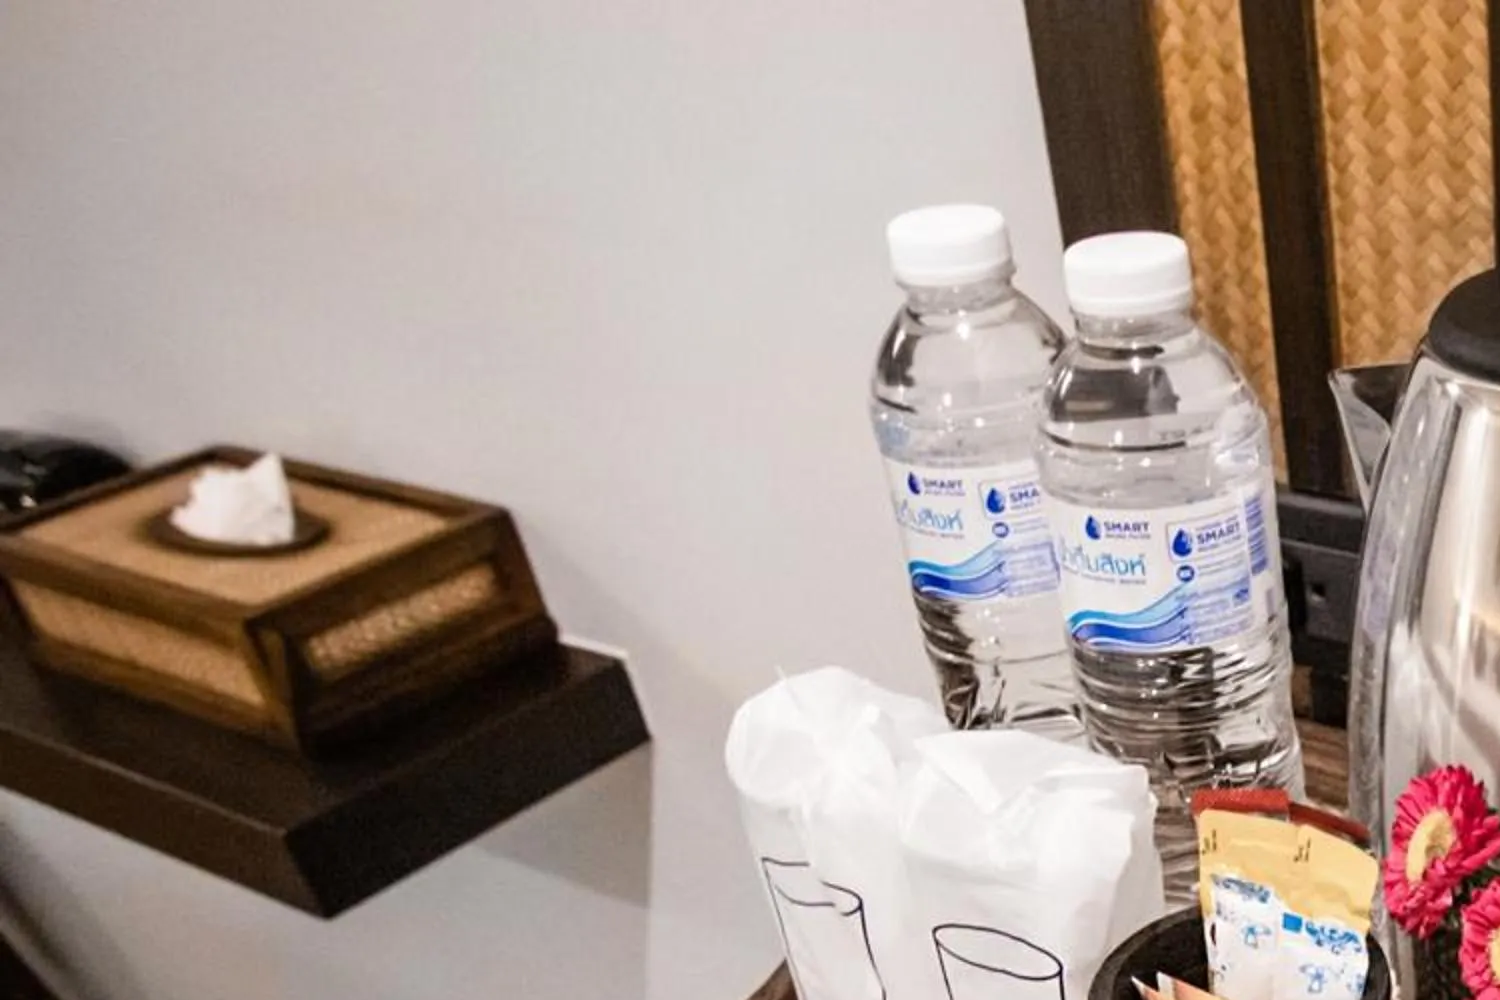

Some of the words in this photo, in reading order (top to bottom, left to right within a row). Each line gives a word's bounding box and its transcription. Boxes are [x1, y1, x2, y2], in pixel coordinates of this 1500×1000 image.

[922, 478, 963, 489] SMART
[1009, 488, 1040, 503] SMA
[1103, 521, 1149, 532] SMART
[1196, 521, 1241, 545] SMART
